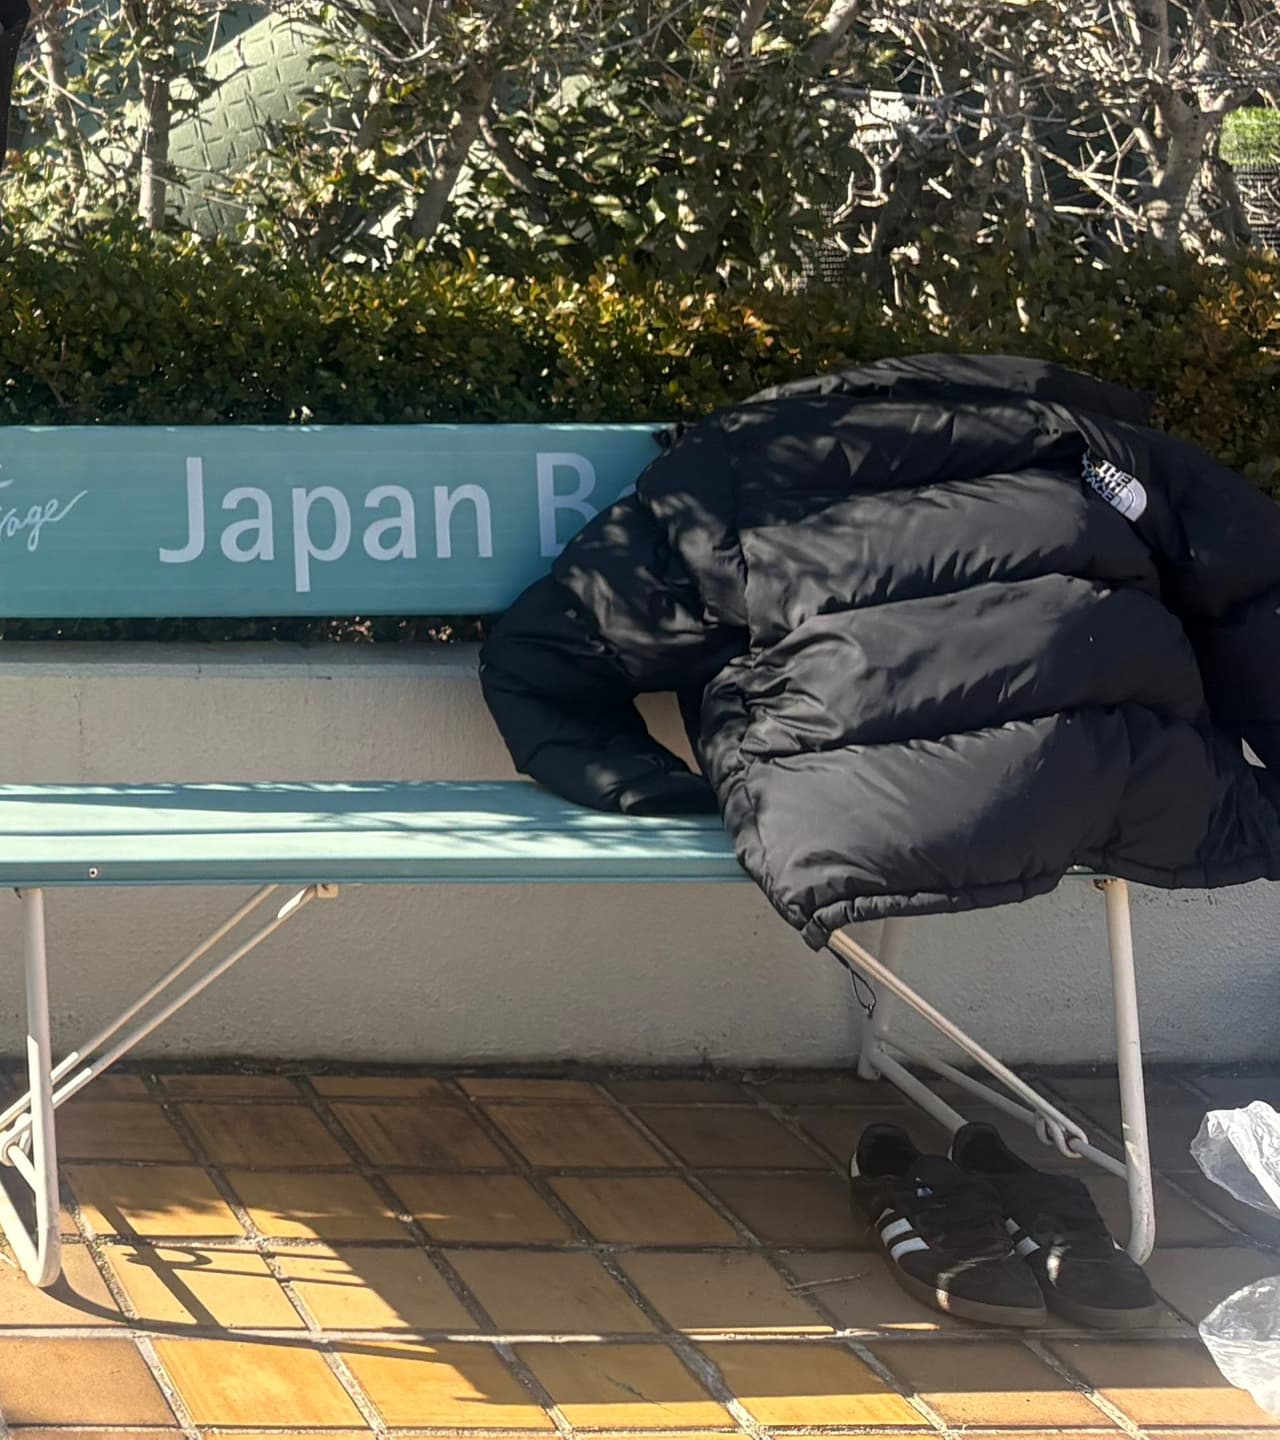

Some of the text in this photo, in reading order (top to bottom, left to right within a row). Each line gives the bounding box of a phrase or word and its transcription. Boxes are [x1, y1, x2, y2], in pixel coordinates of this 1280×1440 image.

[1097, 460, 1133, 486] THE
[159, 452, 636, 593] Japan B
